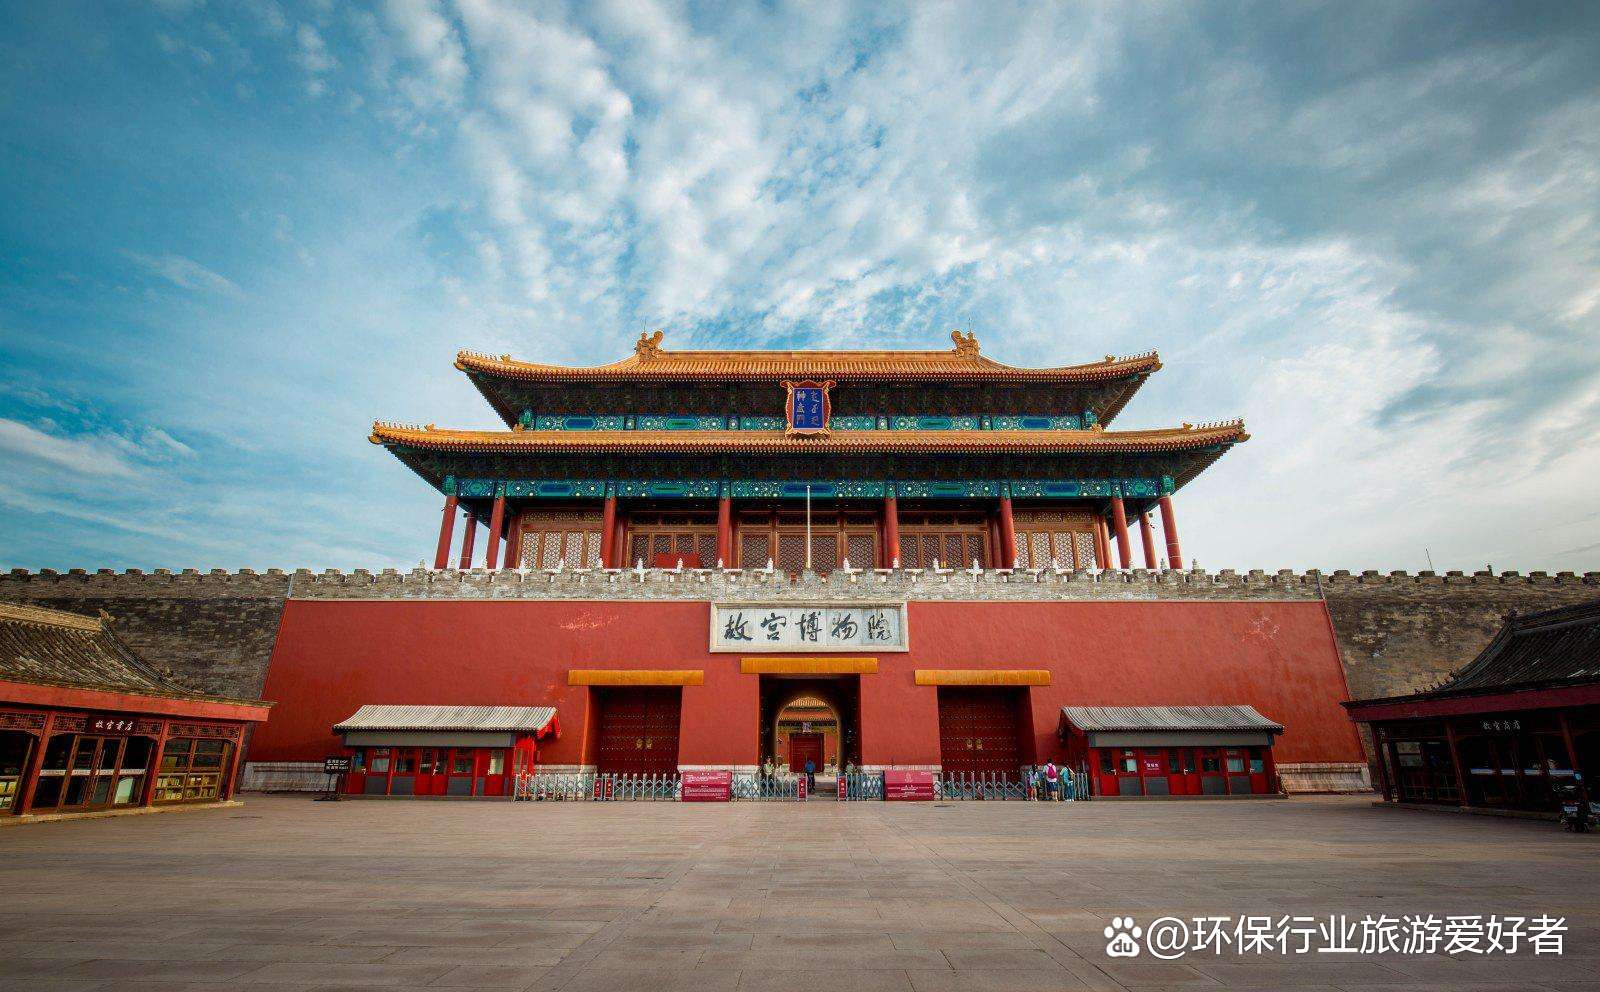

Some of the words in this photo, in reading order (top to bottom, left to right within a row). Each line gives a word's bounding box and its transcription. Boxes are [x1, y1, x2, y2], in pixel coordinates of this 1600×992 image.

[723, 611, 892, 642] 故宫博物院
